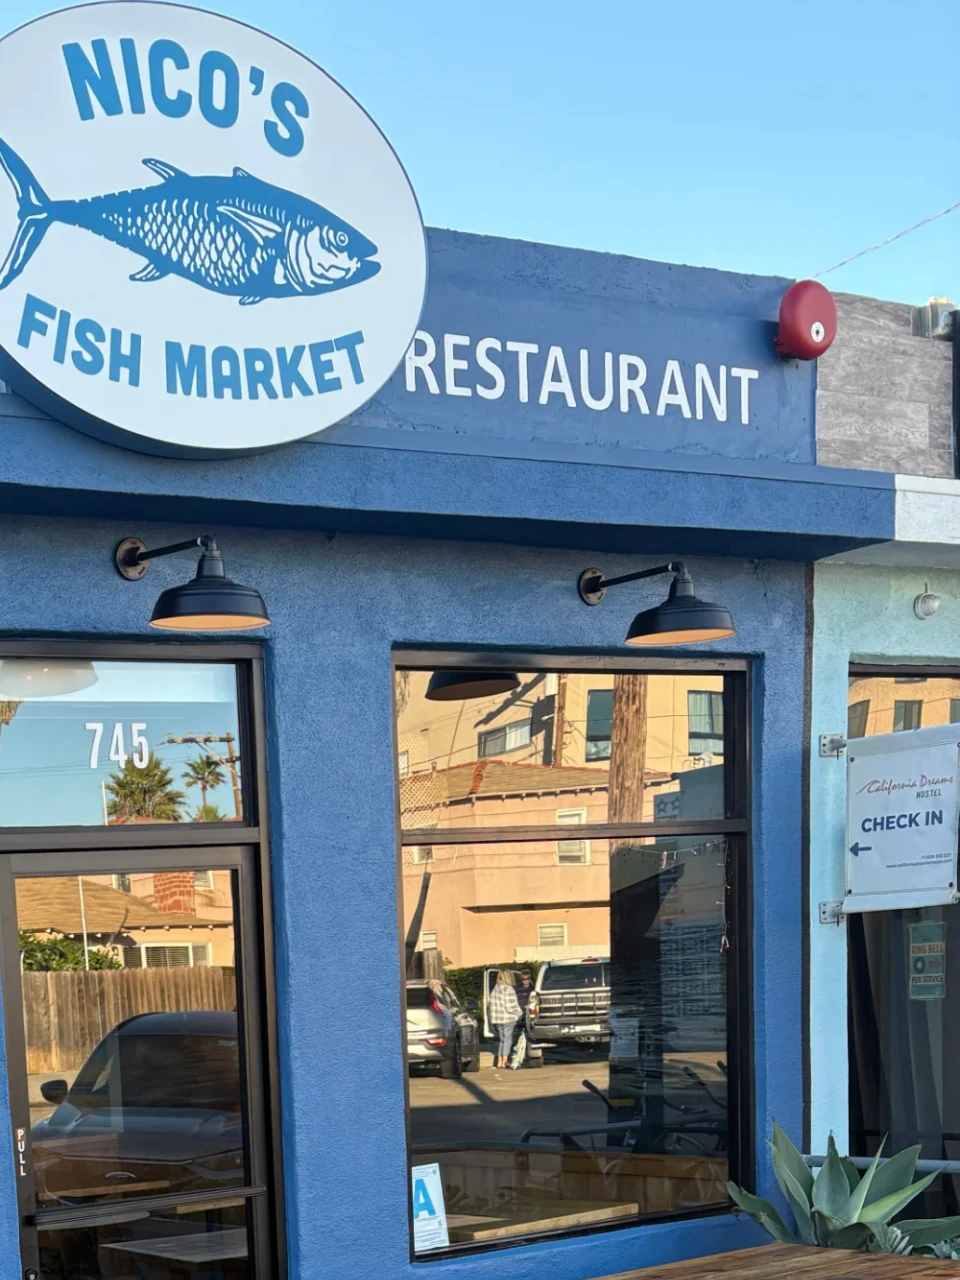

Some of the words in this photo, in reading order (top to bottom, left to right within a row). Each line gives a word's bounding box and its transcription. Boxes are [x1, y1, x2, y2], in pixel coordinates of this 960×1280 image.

[62, 38, 310, 157] NICO'S
[17, 293, 142, 388] FISH
[164, 331, 366, 401] MARKET
[405, 329, 759, 425] RESTAURANT
[85, 722, 149, 769] 745
[856, 780, 917, 795] California
[920, 774, 953, 788] Dreams
[916, 788, 942, 799] HOSTEL
[861, 812, 921, 832] CHECK
[925, 810, 943, 826] IN
[912, 945, 927, 954] RING
[928, 944, 944, 953] BELL
[923, 975, 944, 983] SERVICE
[17, 1128, 27, 1177] PULL
[413, 1178, 436, 1219] A
